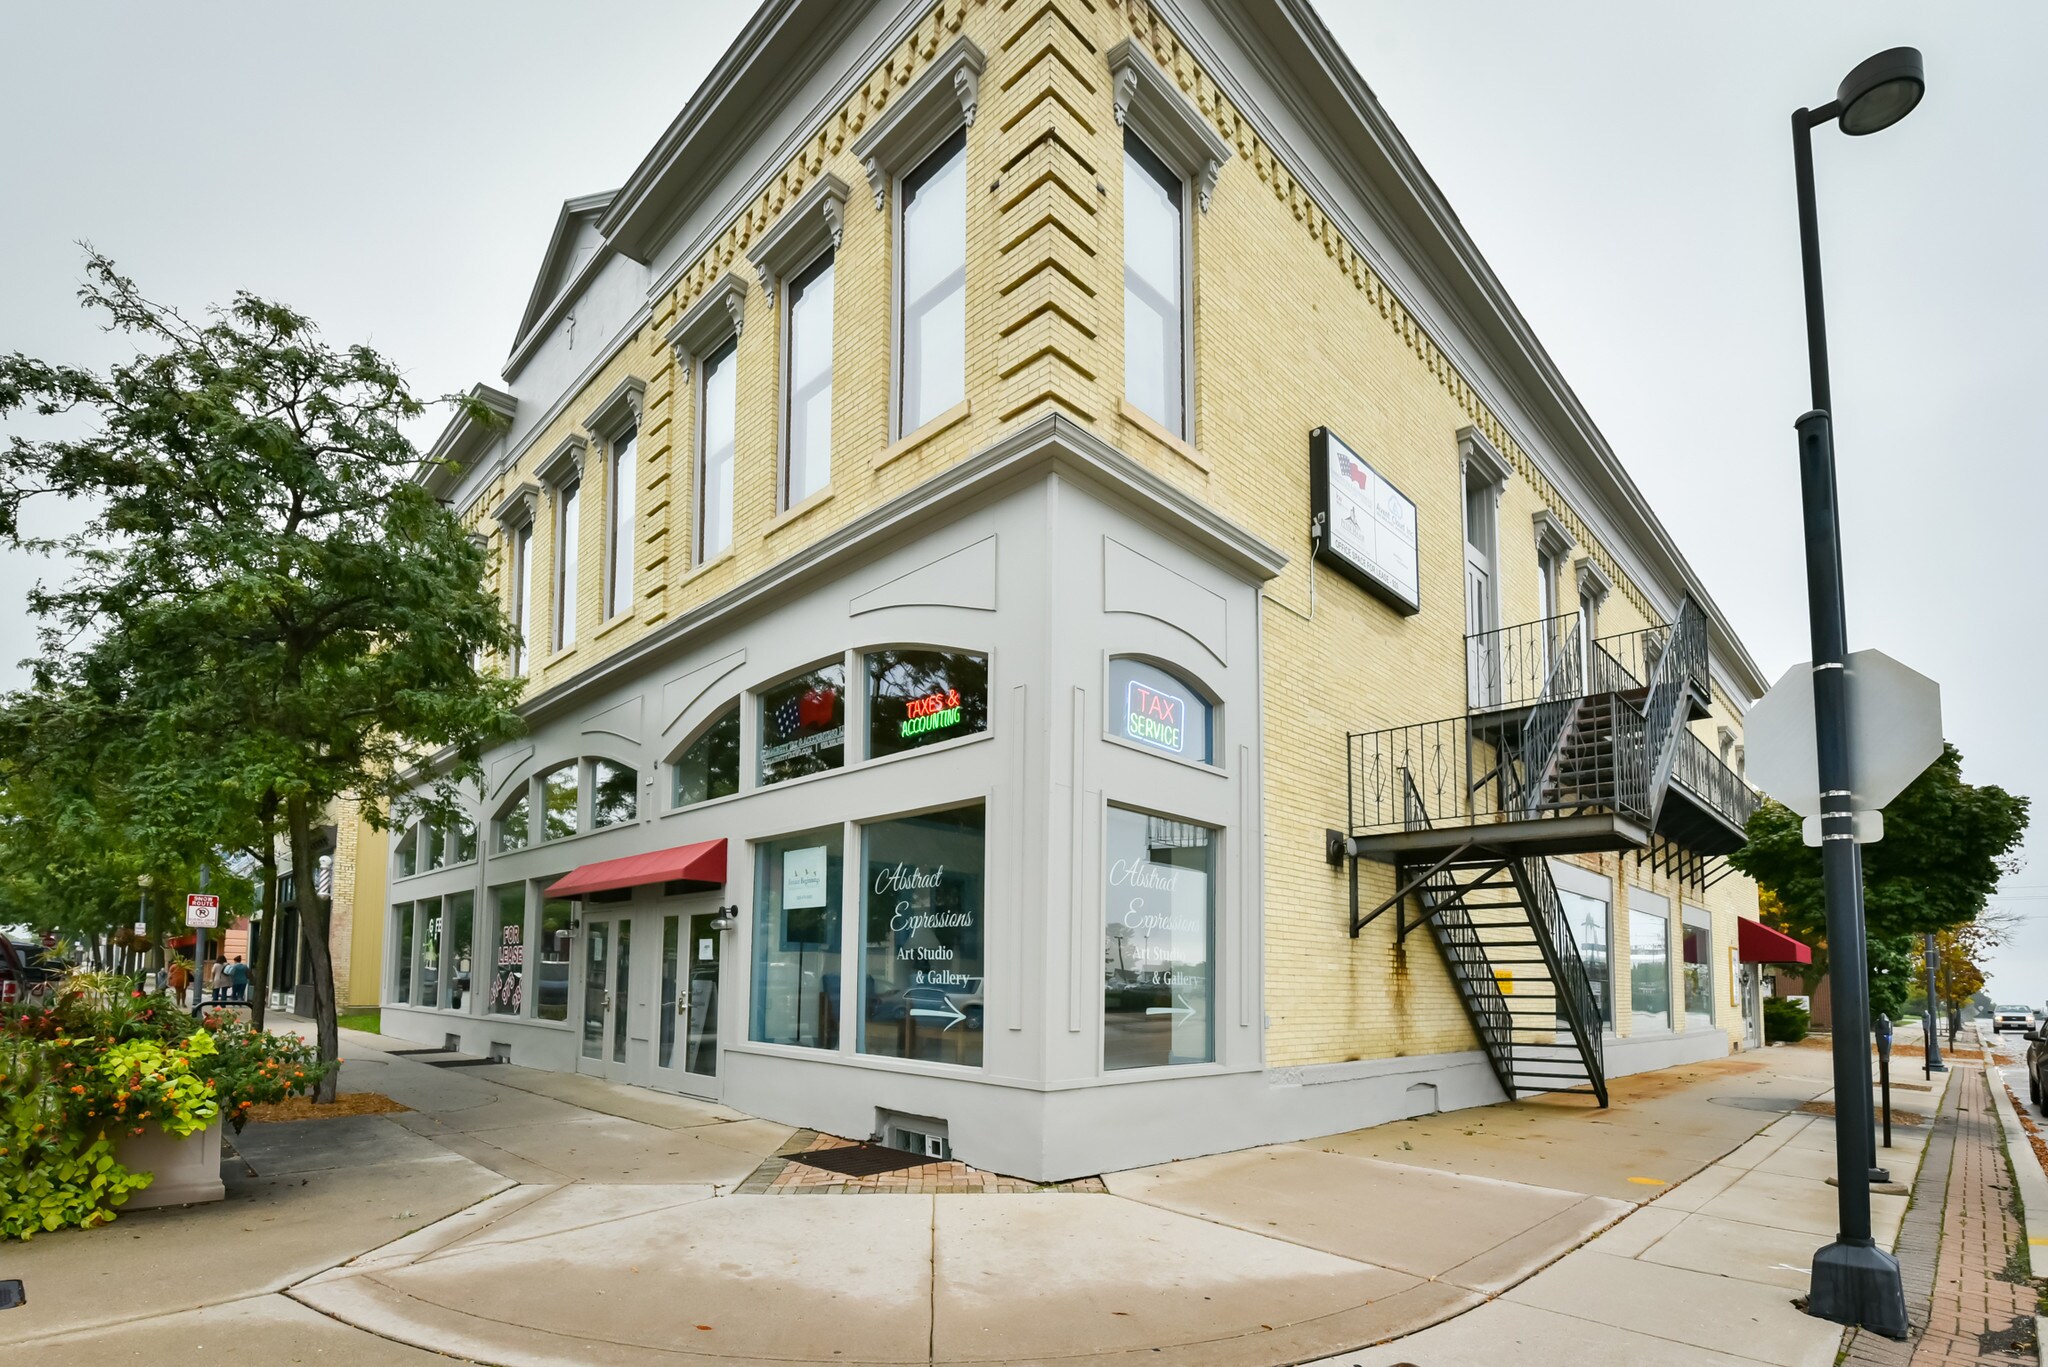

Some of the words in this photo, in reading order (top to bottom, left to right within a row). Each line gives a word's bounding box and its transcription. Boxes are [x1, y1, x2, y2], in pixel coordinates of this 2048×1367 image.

[1335, 539, 1351, 556] OFFICE
[1352, 550, 1366, 568] SPACE
[1367, 561, 1375, 573] FOR
[1376, 567, 1390, 583] LEASE
[906, 693, 944, 719] TAXES
[946, 689, 960, 707] &
[1137, 688, 1174, 724] TAX
[902, 706, 960, 738] ACCOUNTING
[1130, 712, 1179, 748] SERVICE
[874, 861, 944, 895] Abstract
[1109, 857, 1178, 892] Abstract
[890, 901, 973, 938] Expressions
[1124, 897, 1200, 937] Expressions
[503, 925, 519, 945] FOR
[498, 945, 523, 965] LEASE
[897, 947, 915, 960] Art
[917, 946, 954, 960] Studio
[1133, 946, 1150, 960] Art
[1153, 946, 1186, 961] Studio
[916, 970, 925, 985] &
[928, 970, 971, 988] Gallery
[1152, 970, 1160, 985] &
[1164, 970, 1199, 988] Gallery
